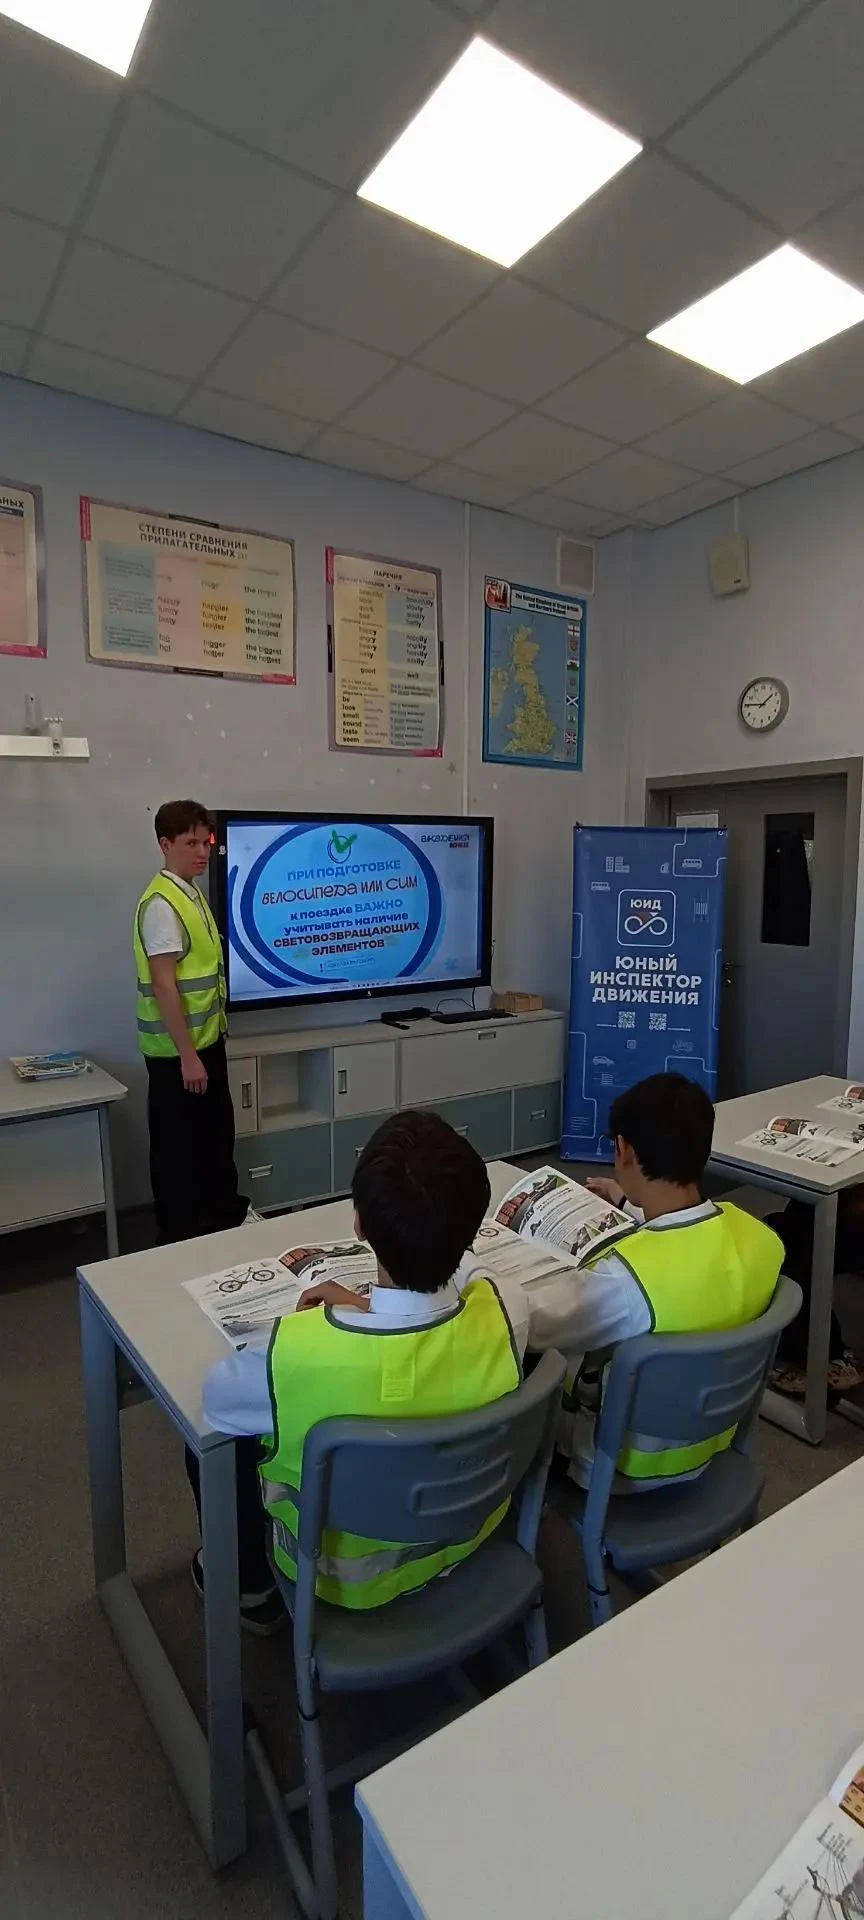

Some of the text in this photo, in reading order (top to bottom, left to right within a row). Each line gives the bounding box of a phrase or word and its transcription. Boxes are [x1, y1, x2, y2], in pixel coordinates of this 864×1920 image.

[138, 523, 248, 550] СТЕПЕНИ СРАВНЕНИЯ
[140, 533, 236, 558] ПРИЛАГАТЕЛЬНЫХ
[287, 860, 401, 881] ПРИ ПОДГОТОВКЕ
[361, 880, 383, 894] ИЛИ
[300, 906, 353, 919] поездке
[354, 899, 403, 913] ВАЖНО
[630, 898, 662, 910] ЮИД
[284, 912, 409, 937] учитывать наличие
[273, 921, 420, 948] СВЕТОВОЗВРАЩАЮЩИХ
[311, 939, 385, 957] ЭЛЕМЕНТОВ
[615, 953, 677, 971] ЮНЫЙ
[590, 971, 702, 989] ИНСПЕКТОР
[592, 987, 699, 1005] ДВИЖЕНИЯ
